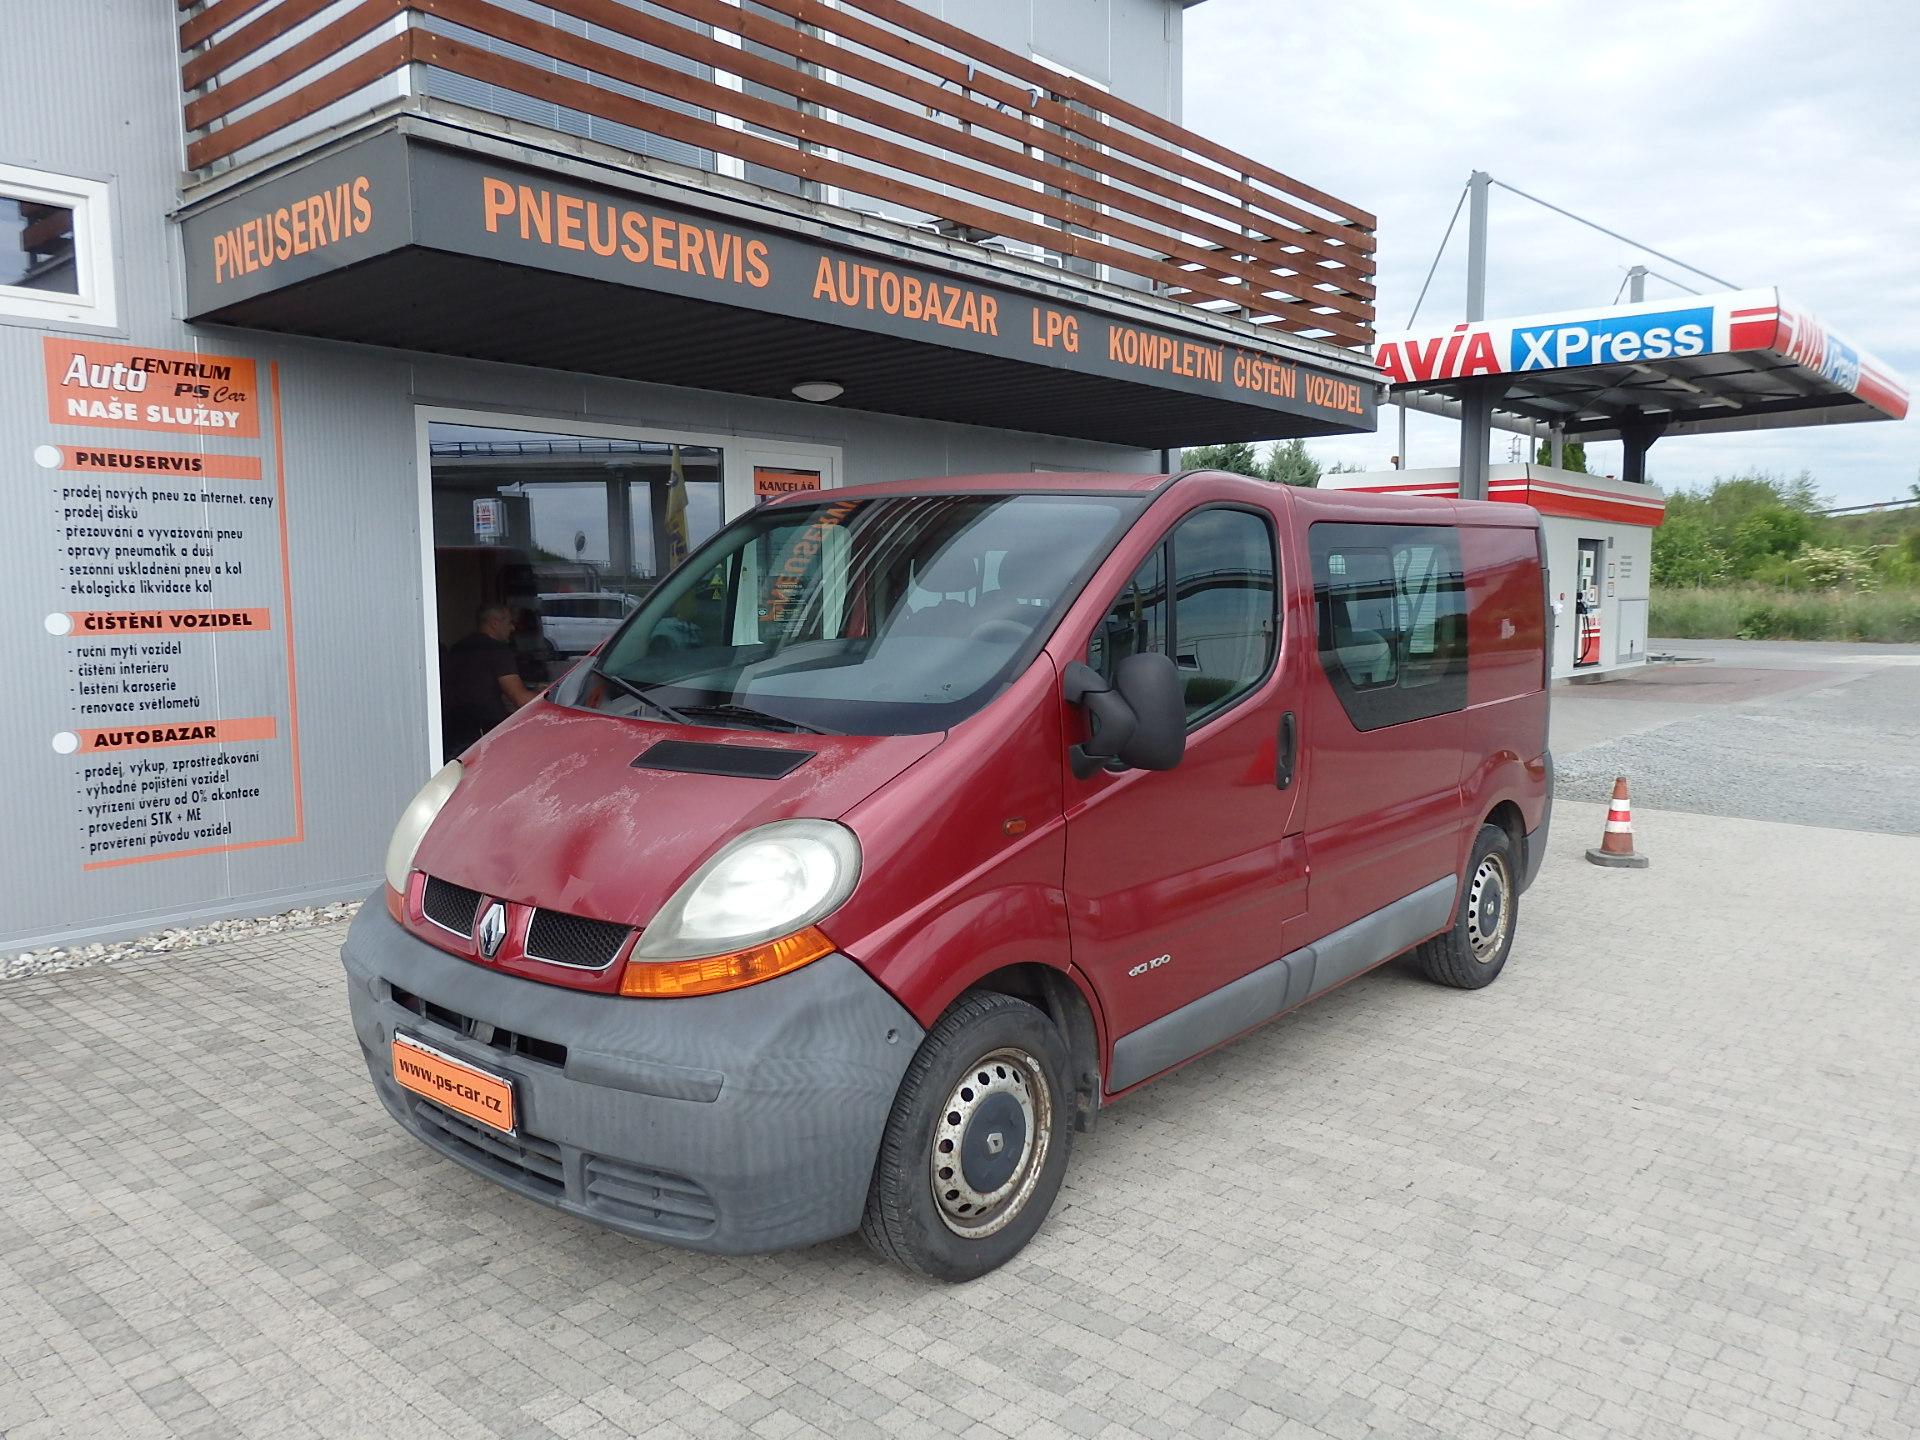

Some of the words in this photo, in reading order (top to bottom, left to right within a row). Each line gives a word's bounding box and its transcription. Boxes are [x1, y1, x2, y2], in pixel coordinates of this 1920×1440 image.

[213, 176, 372, 284] PNEUSERVIS
[483, 176, 769, 287] PNEUSERVIS
[813, 256, 999, 336] AUTOBAZAR
[1032, 308, 1078, 352] LPG
[1109, 325, 1223, 382] KOMPLETNÍ
[1233, 347, 1296, 398] ČIŠTĚNÍ
[1306, 374, 1363, 414] VOZIDEL
[1520, 324, 1704, 371] XPress
[61, 353, 148, 392] Auto
[131, 357, 231, 380] CENTRUM
[174, 383, 210, 399] PS
[213, 386, 247, 403] Car
[68, 396, 139, 421] NAŠE
[146, 404, 240, 429] SLUŽBY
[76, 452, 202, 471] PNEUSERVIS
[63, 484, 102, 502] prodej
[105, 486, 148, 503] nových
[152, 491, 179, 504] pneu
[183, 492, 196, 502] za
[250, 496, 274, 508] ceny
[64, 504, 103, 521] prodej
[137, 528, 144, 538] a
[217, 530, 243, 542] pneu
[67, 547, 110, 560] opravy
[115, 543, 177, 560] pneumatik
[181, 547, 188, 557] a
[185, 565, 211, 578] pneu
[215, 566, 222, 575] a
[225, 562, 242, 575] kol
[140, 580, 192, 593] likvidace
[195, 580, 212, 593] kol
[84, 612, 163, 630] ČIŠTĚNÍ
[169, 613, 252, 628] VOZIDEL
[141, 641, 182, 655] vozidel
[123, 678, 177, 693] karoserie
[81, 702, 135, 714] renovace
[94, 726, 216, 747] AUTOBAZAR
[191, 769, 229, 785] vozidel
[174, 791, 188, 805] od
[192, 789, 207, 803] 0%
[211, 788, 260, 801] akontace
[151, 811, 173, 826] STK
[187, 808, 202, 822] ME
[194, 822, 232, 838] vozidel
[1150, 954, 1171, 969] 100
[399, 1058, 503, 1113] www.ps-car.cz
